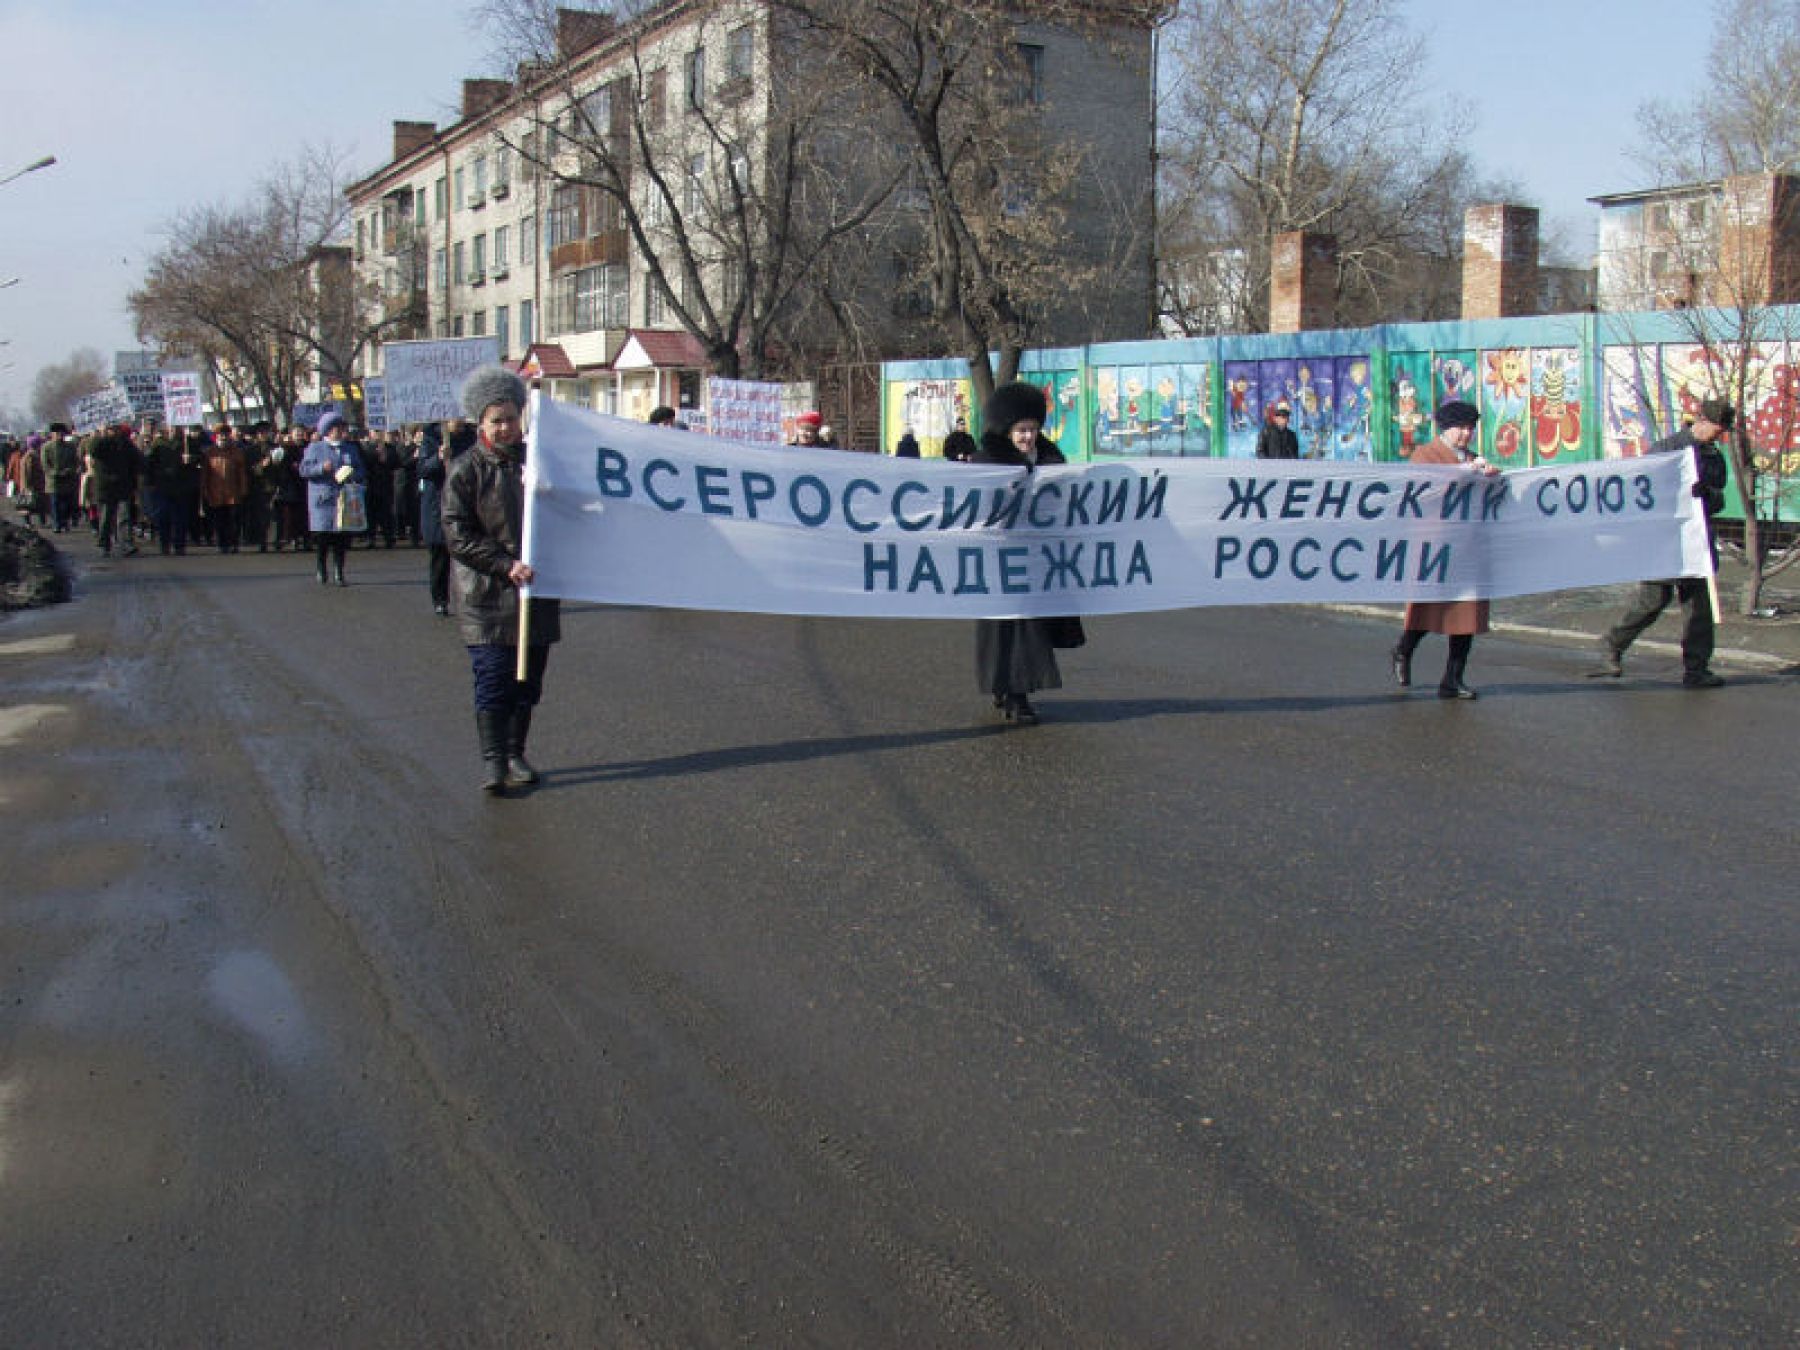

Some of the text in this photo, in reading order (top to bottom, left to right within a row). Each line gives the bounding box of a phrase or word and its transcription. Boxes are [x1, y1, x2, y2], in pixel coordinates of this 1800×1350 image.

[596, 447, 1655, 533] ВСЕРОССИЙСКИЙ ЖЕНСКИЙ СОЮЗ
[864, 537, 1452, 595] НАДЕЖДА РОССИИ
